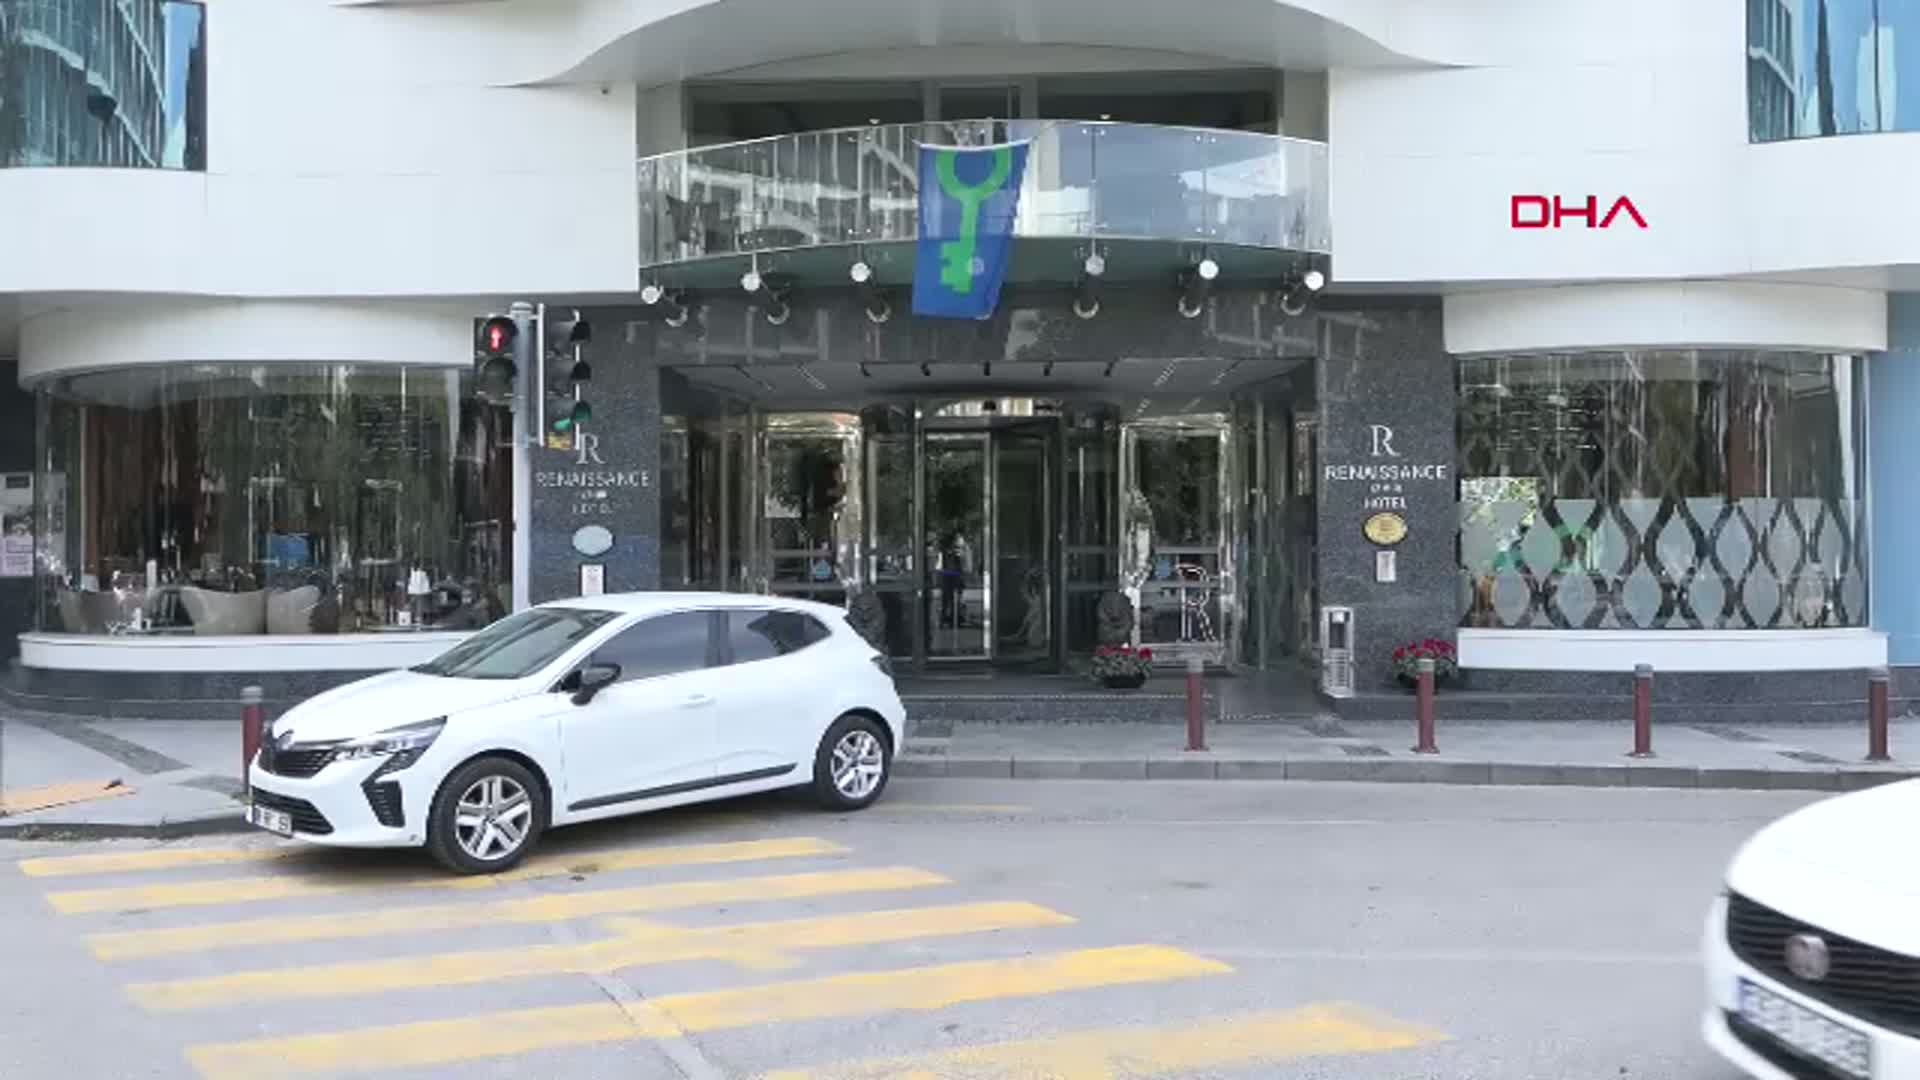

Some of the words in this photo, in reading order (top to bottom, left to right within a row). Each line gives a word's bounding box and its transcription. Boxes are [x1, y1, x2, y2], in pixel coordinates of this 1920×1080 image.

[1369, 424, 1400, 456] R
[576, 433, 607, 464] R
[536, 471, 649, 487] RENAISSANCE
[1325, 465, 1447, 480] RENAISSANCE
[1364, 497, 1407, 509] HOTEL
